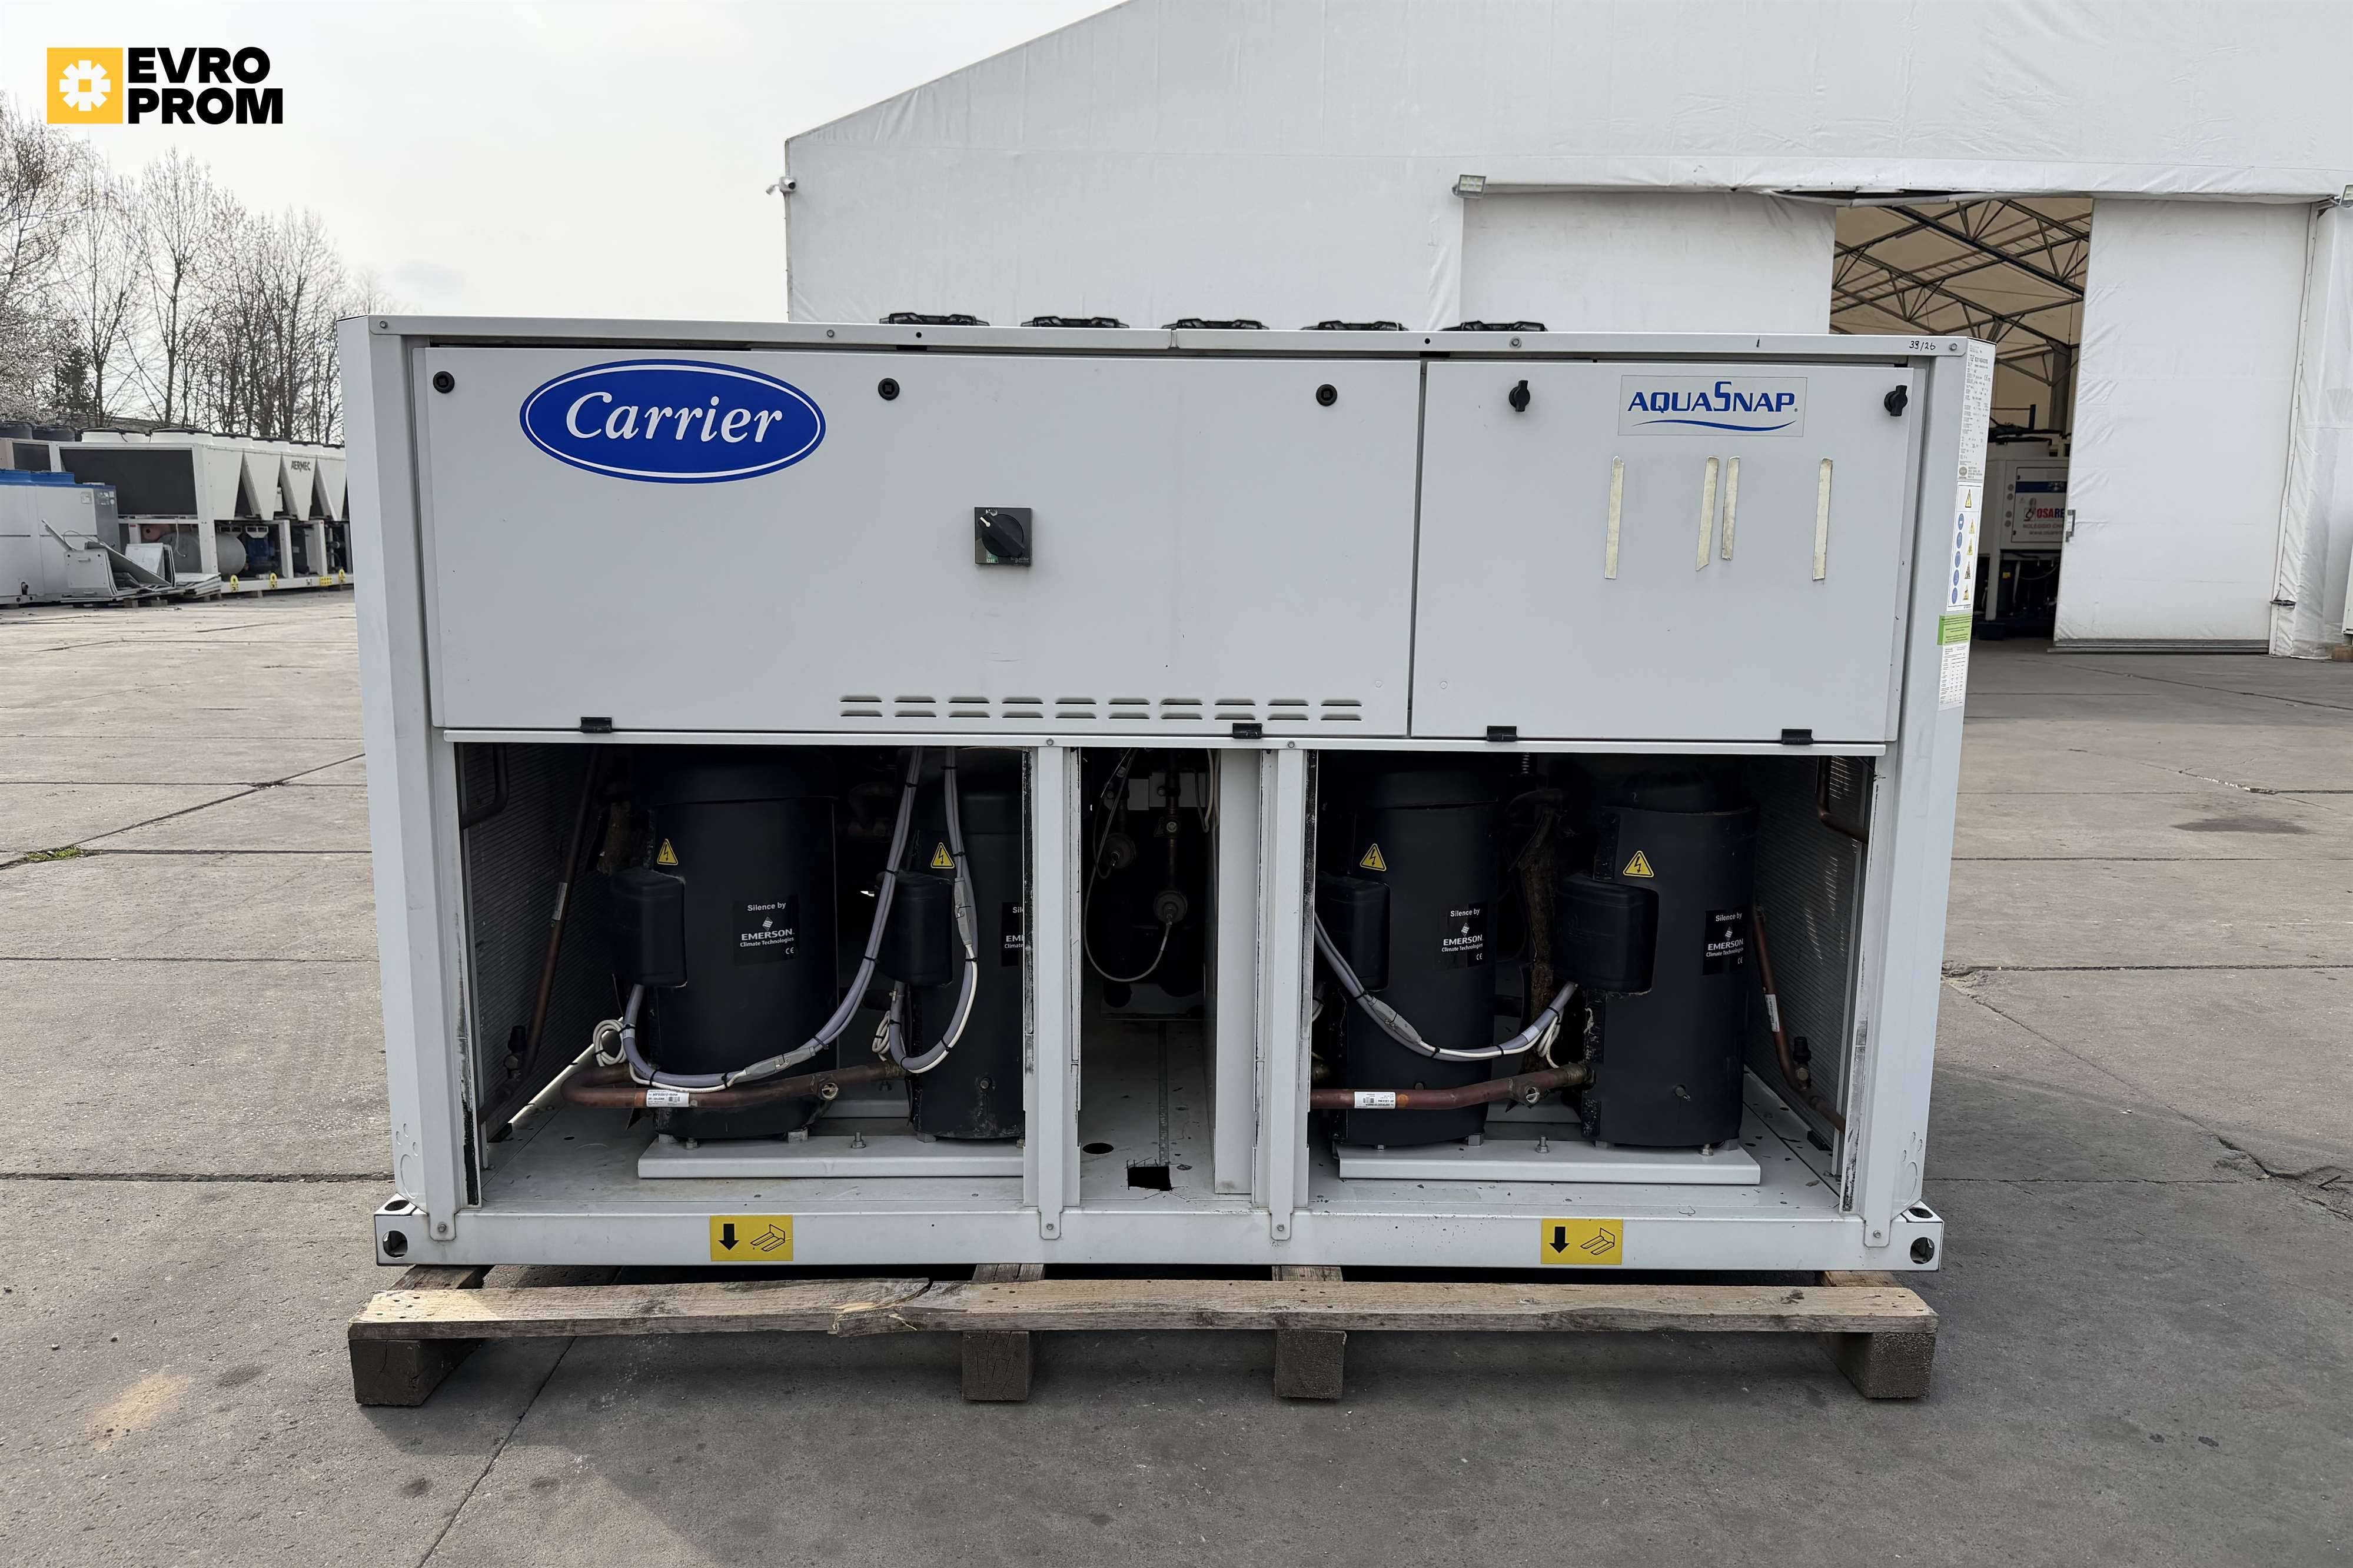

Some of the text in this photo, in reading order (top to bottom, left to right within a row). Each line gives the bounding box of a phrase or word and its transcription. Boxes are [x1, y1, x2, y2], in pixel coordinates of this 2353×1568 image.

[566, 392, 783, 442] Carrier
[291, 461, 311, 472] AERMEC
[742, 928, 792, 940] EMERSON
[1443, 934, 1482, 946] EMERSON
[1708, 938, 1743, 950] EMERSON
